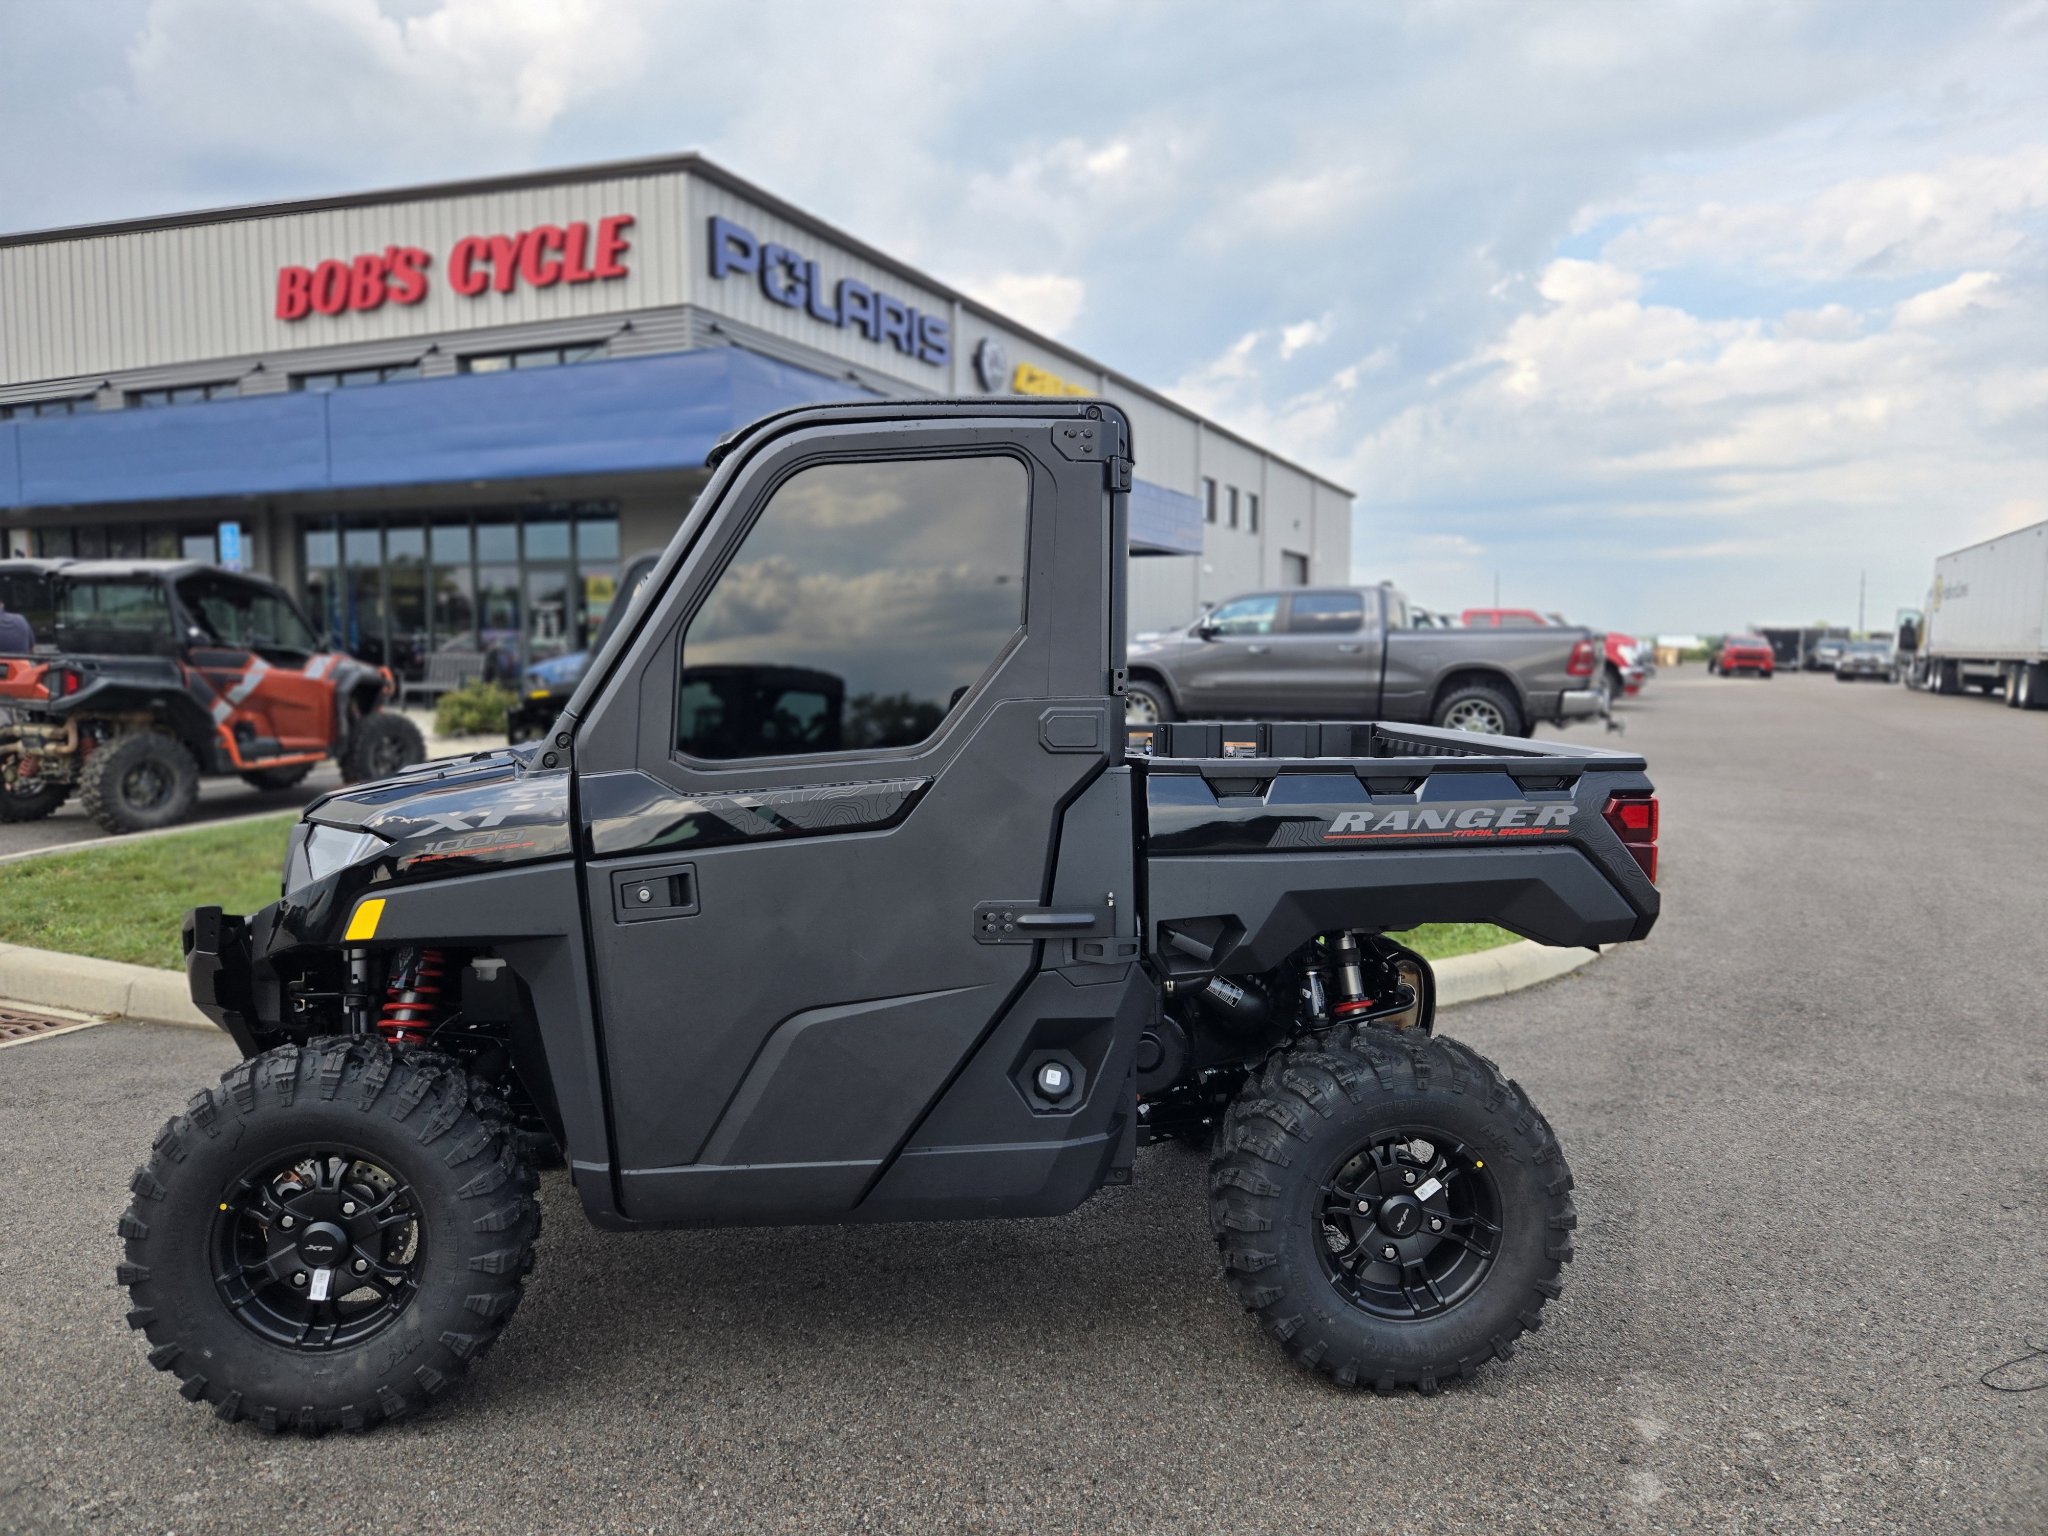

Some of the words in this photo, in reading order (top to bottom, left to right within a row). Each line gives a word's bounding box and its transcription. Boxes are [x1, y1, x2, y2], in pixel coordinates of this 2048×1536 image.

[275, 245, 431, 321] BOB'S
[447, 214, 634, 297] CYCLE
[707, 214, 950, 368] POLARIS
[1327, 805, 1579, 833] RANGER
[423, 829, 528, 853] 1000
[1452, 829, 1494, 838] TRAIL
[1498, 827, 1545, 836] BOSS
[304, 1244, 333, 1252] XP
